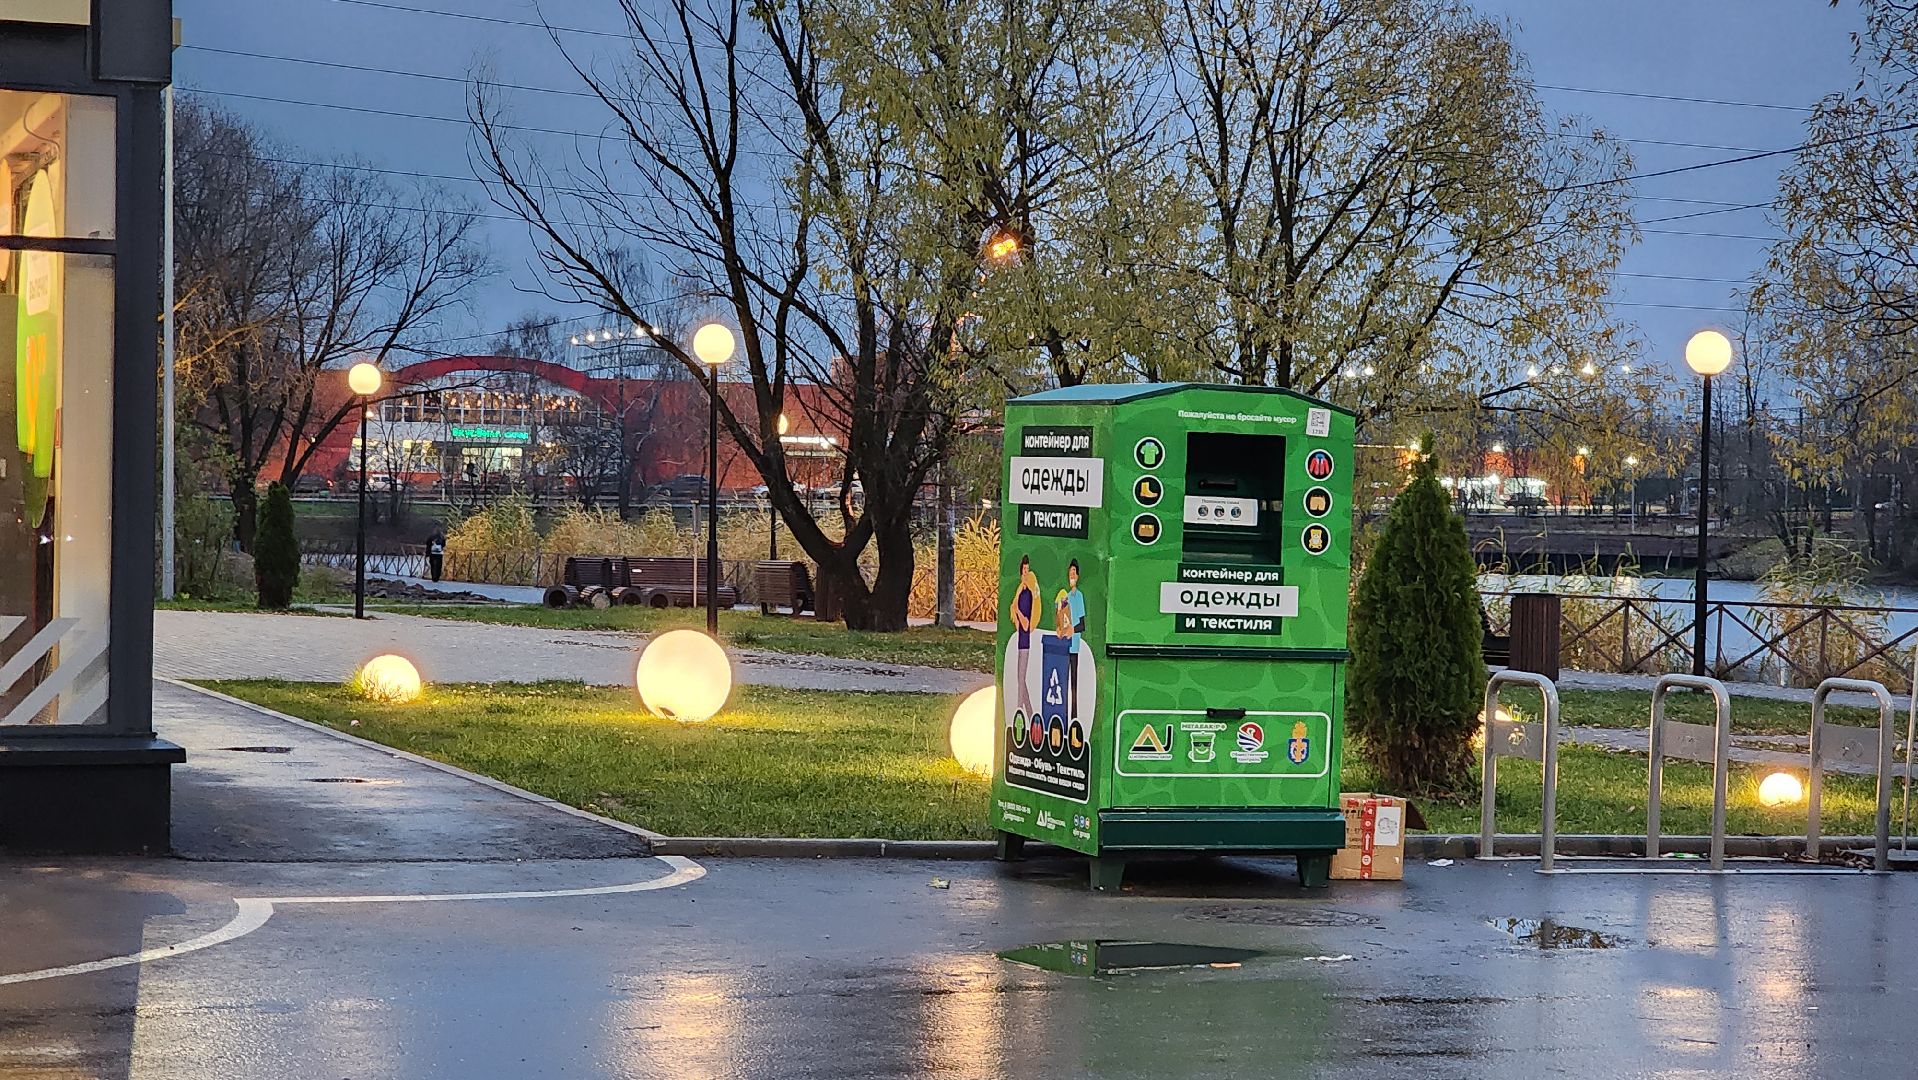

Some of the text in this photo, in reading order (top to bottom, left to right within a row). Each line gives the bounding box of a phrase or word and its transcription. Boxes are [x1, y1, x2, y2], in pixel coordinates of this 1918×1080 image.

[1178, 410, 1225, 420] Пожалуйста
[1237, 412, 1272, 422] бросайте
[1273, 416, 1297, 424] мусор
[1024, 432, 1090, 452] контейнер для
[1022, 468, 1089, 496] одежды
[1023, 511, 1083, 529] и текстиля
[1183, 568, 1279, 582] контейнер для
[1180, 590, 1281, 609] одежды
[1185, 618, 1273, 630] и текстиля
[1009, 752, 1086, 779] Одежда Обувь Текстиль
